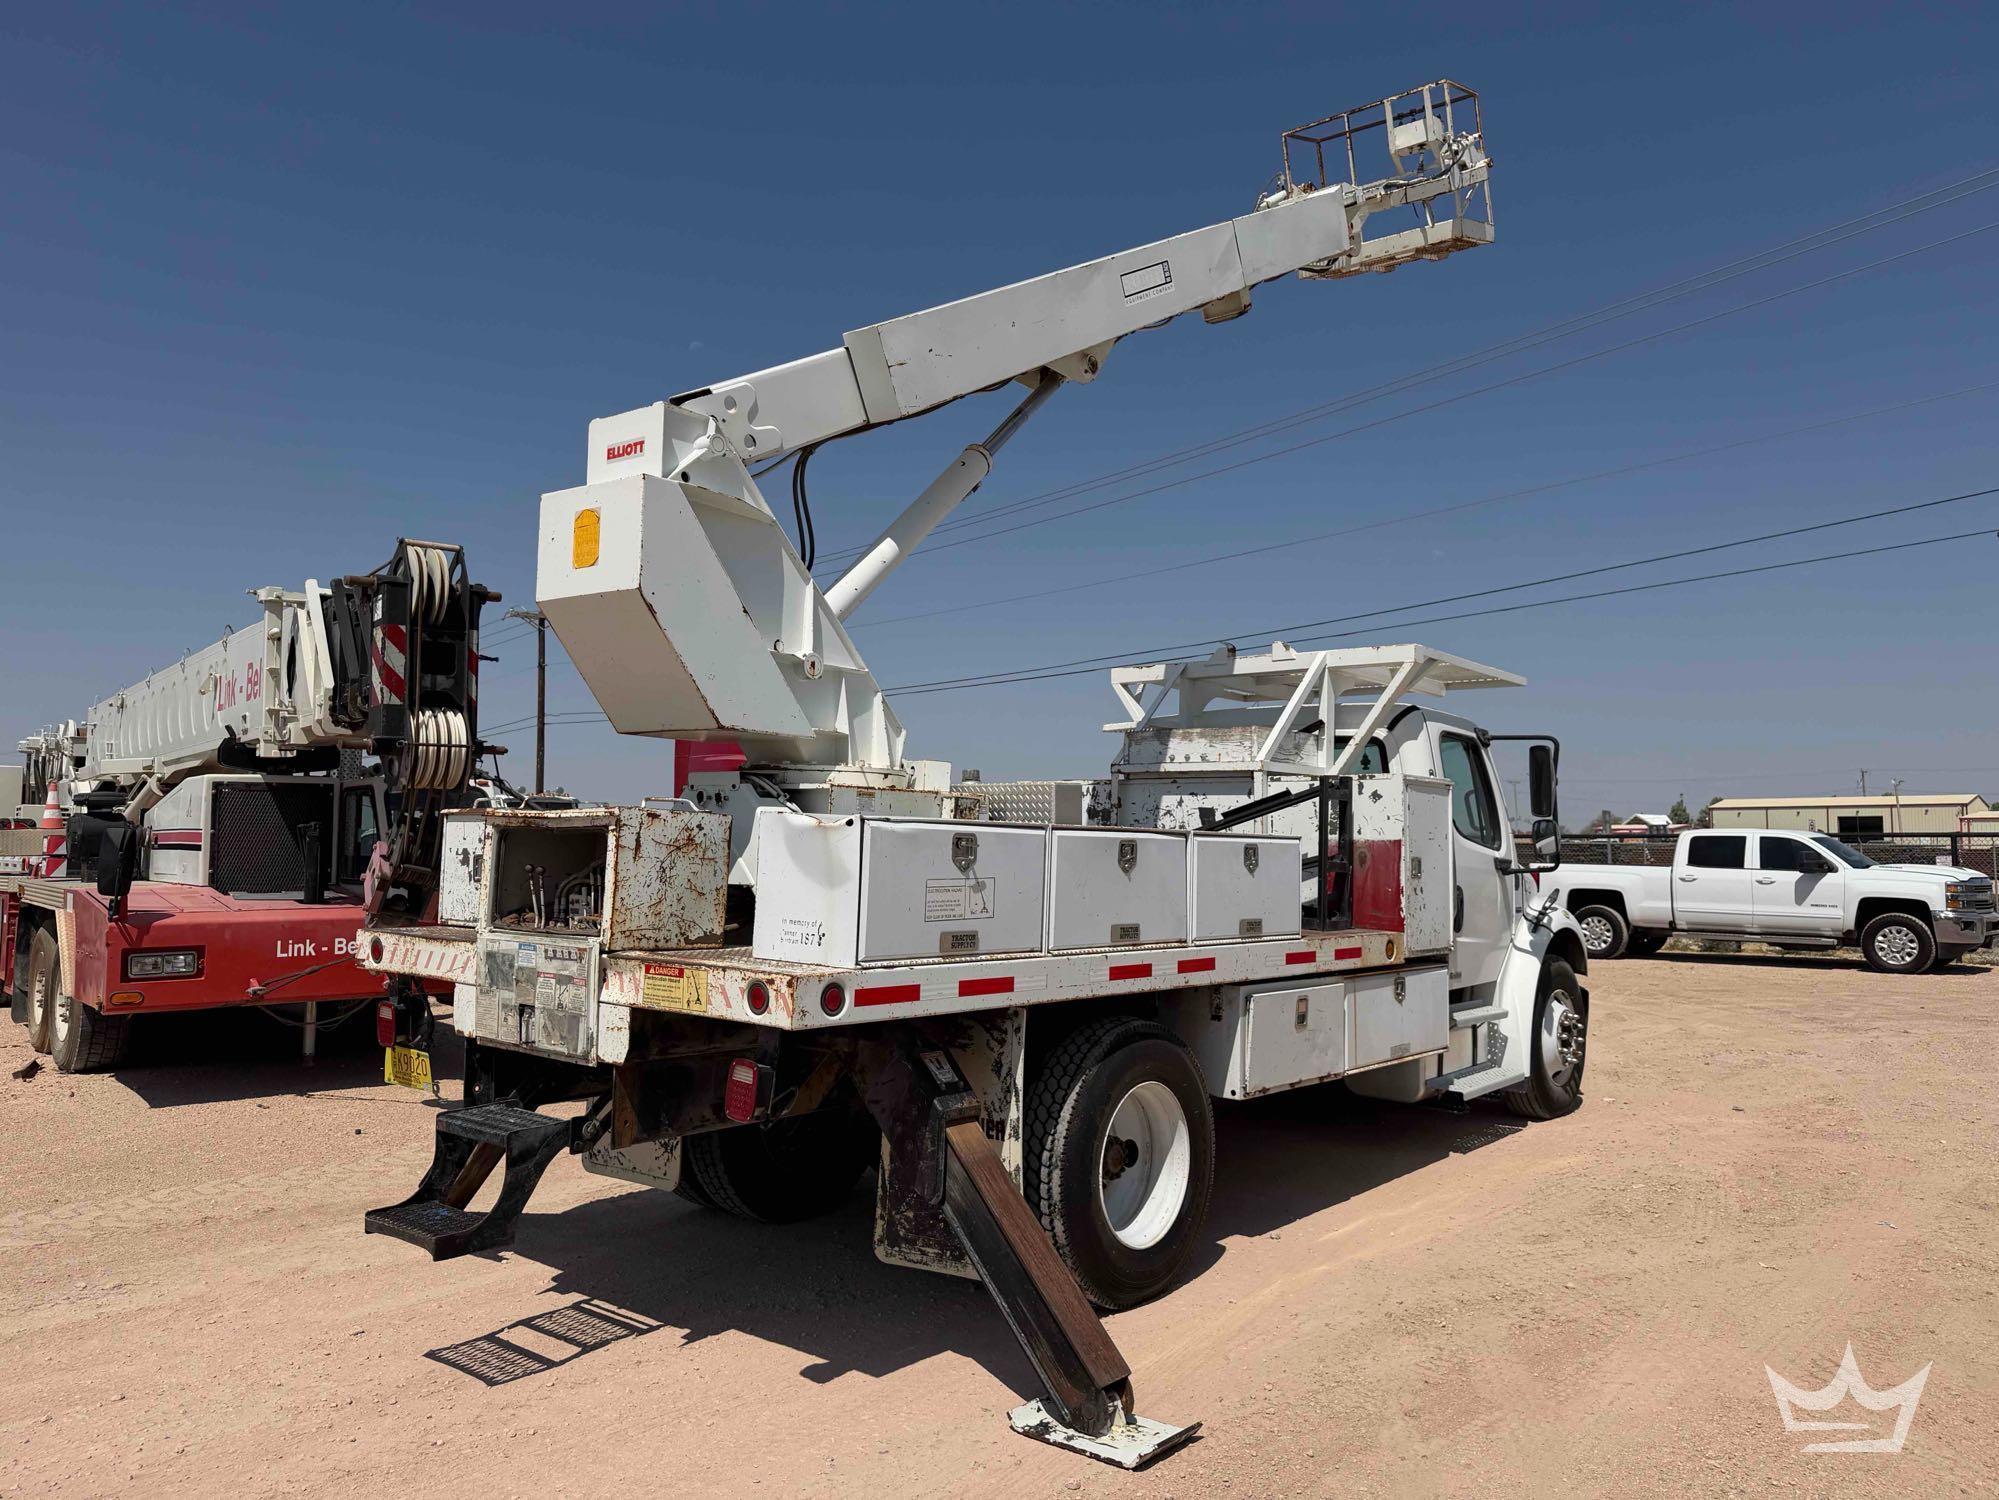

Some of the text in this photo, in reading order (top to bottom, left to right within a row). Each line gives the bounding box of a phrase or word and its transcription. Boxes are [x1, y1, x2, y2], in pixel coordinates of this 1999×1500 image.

[607, 440, 645, 460] ELLIOTT
[217, 669, 237, 711] Link
[952, 934, 976, 942] TRACTOR
[276, 939, 316, 958] Link
[655, 966, 680, 977] DANGER
[397, 1051, 428, 1077] K9020
